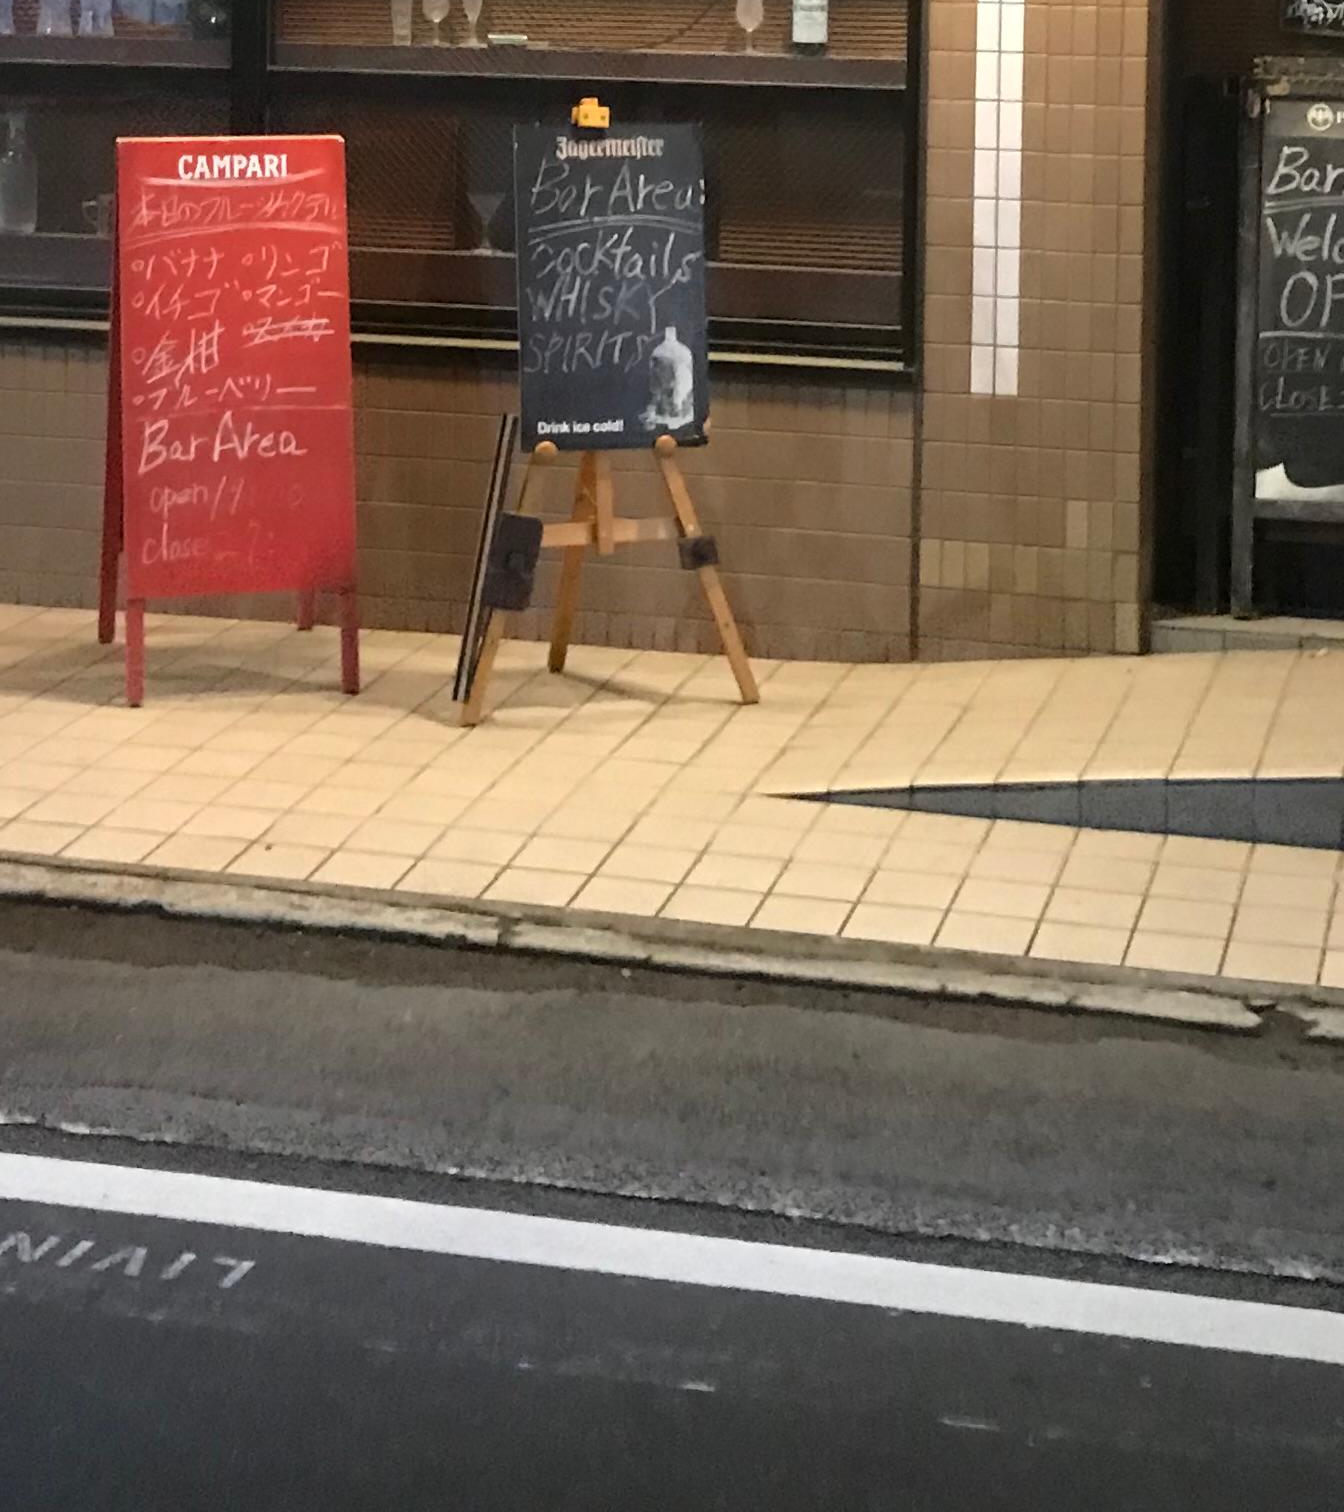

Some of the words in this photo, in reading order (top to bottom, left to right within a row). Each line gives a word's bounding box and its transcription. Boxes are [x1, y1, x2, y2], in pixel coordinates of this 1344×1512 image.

[177, 153, 289, 181] CAMPARI
[530, 157, 603, 217] Bar
[145, 247, 225, 281] バナナ
[261, 240, 344, 281] リンゴ
[144, 279, 241, 321] イチゴ
[255, 277, 345, 309] マンゴー
[526, 275, 670, 335] WHISKY
[141, 318, 225, 385] 金柑
[523, 329, 654, 375] SPIRITS
[137, 418, 208, 476] Bar
[212, 409, 309, 463] Area
[537, 420, 571, 435] Drink
[572, 420, 591, 434] ice
